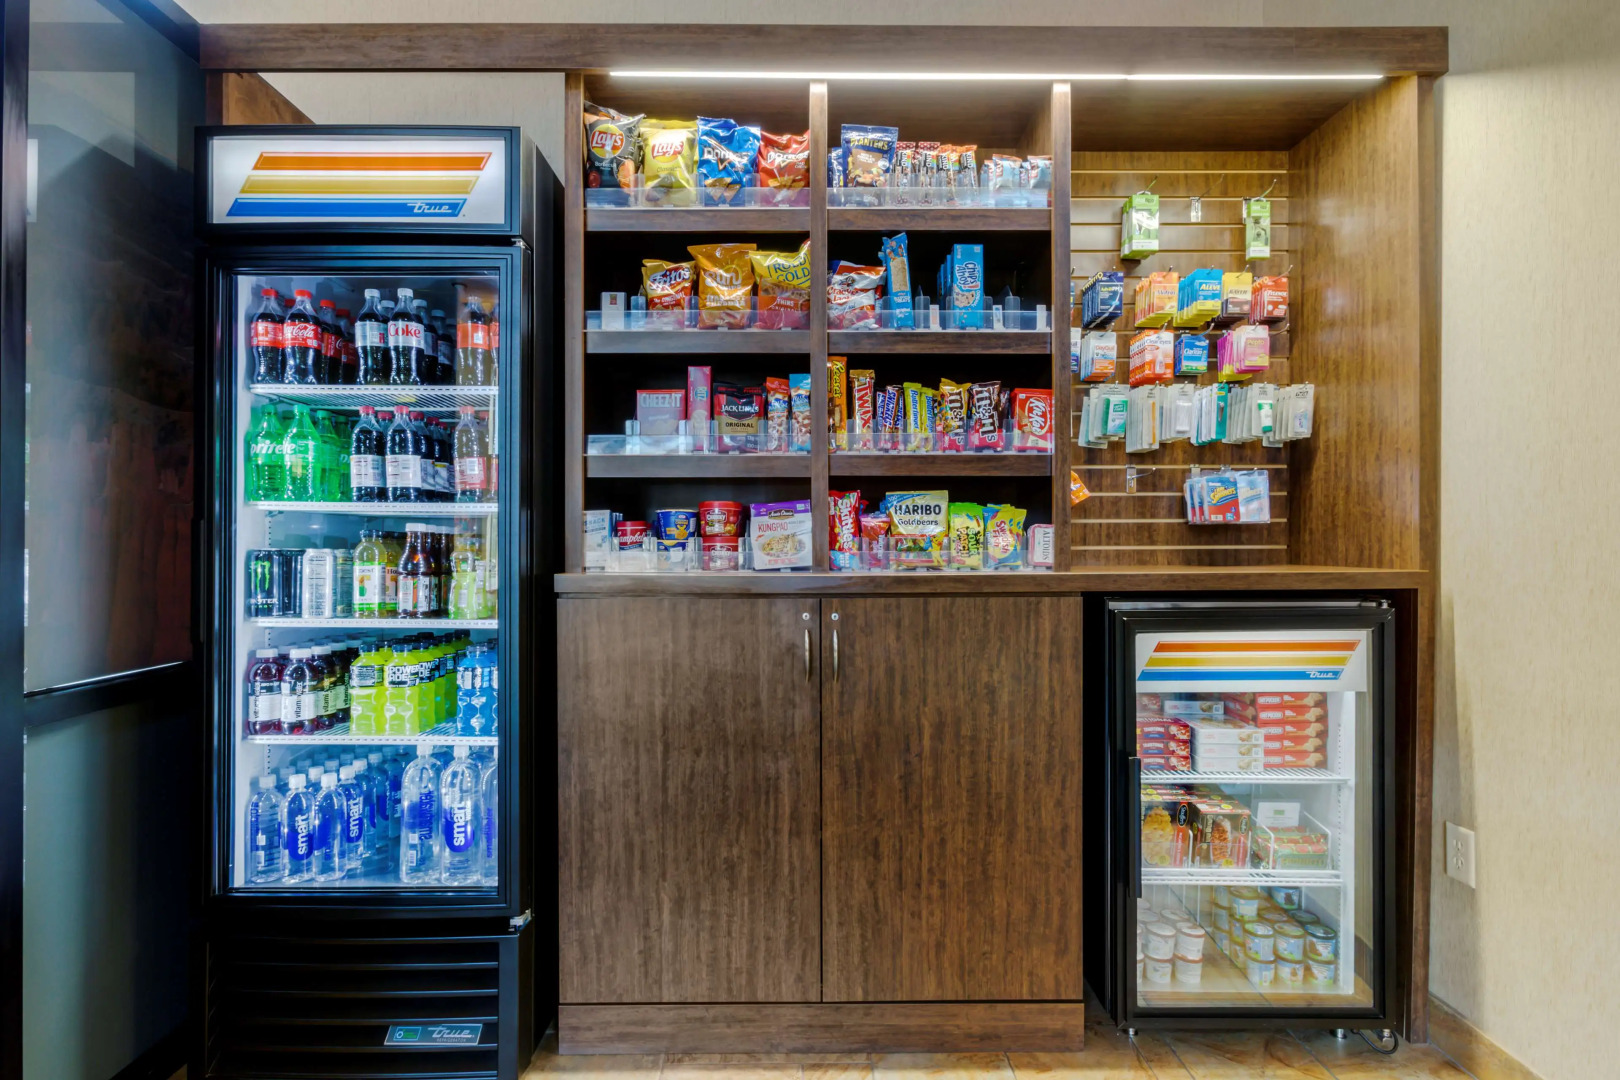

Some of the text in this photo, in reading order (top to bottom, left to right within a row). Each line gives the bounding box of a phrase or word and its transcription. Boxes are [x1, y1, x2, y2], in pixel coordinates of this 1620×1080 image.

[592, 131, 623, 150] Lay's
[653, 141, 683, 156] Lay's
[850, 137, 889, 150] PLANTERS
[649, 268, 691, 287] Fritos
[776, 266, 811, 282] GOLD
[963, 261, 978, 285] Chips
[776, 298, 795, 307] THINS
[389, 322, 421, 338] Coke
[721, 404, 738, 412] JACK
[854, 379, 873, 430] TWIX
[894, 504, 942, 516] HARIBO
[838, 498, 855, 550] Skittles
[898, 518, 939, 526] Goldbears
[967, 527, 978, 556] SOUR
[1042, 529, 1051, 561] ALTOIDS
[348, 797, 360, 838] smart
[452, 801, 466, 846] smart
[295, 813, 309, 855] smart
